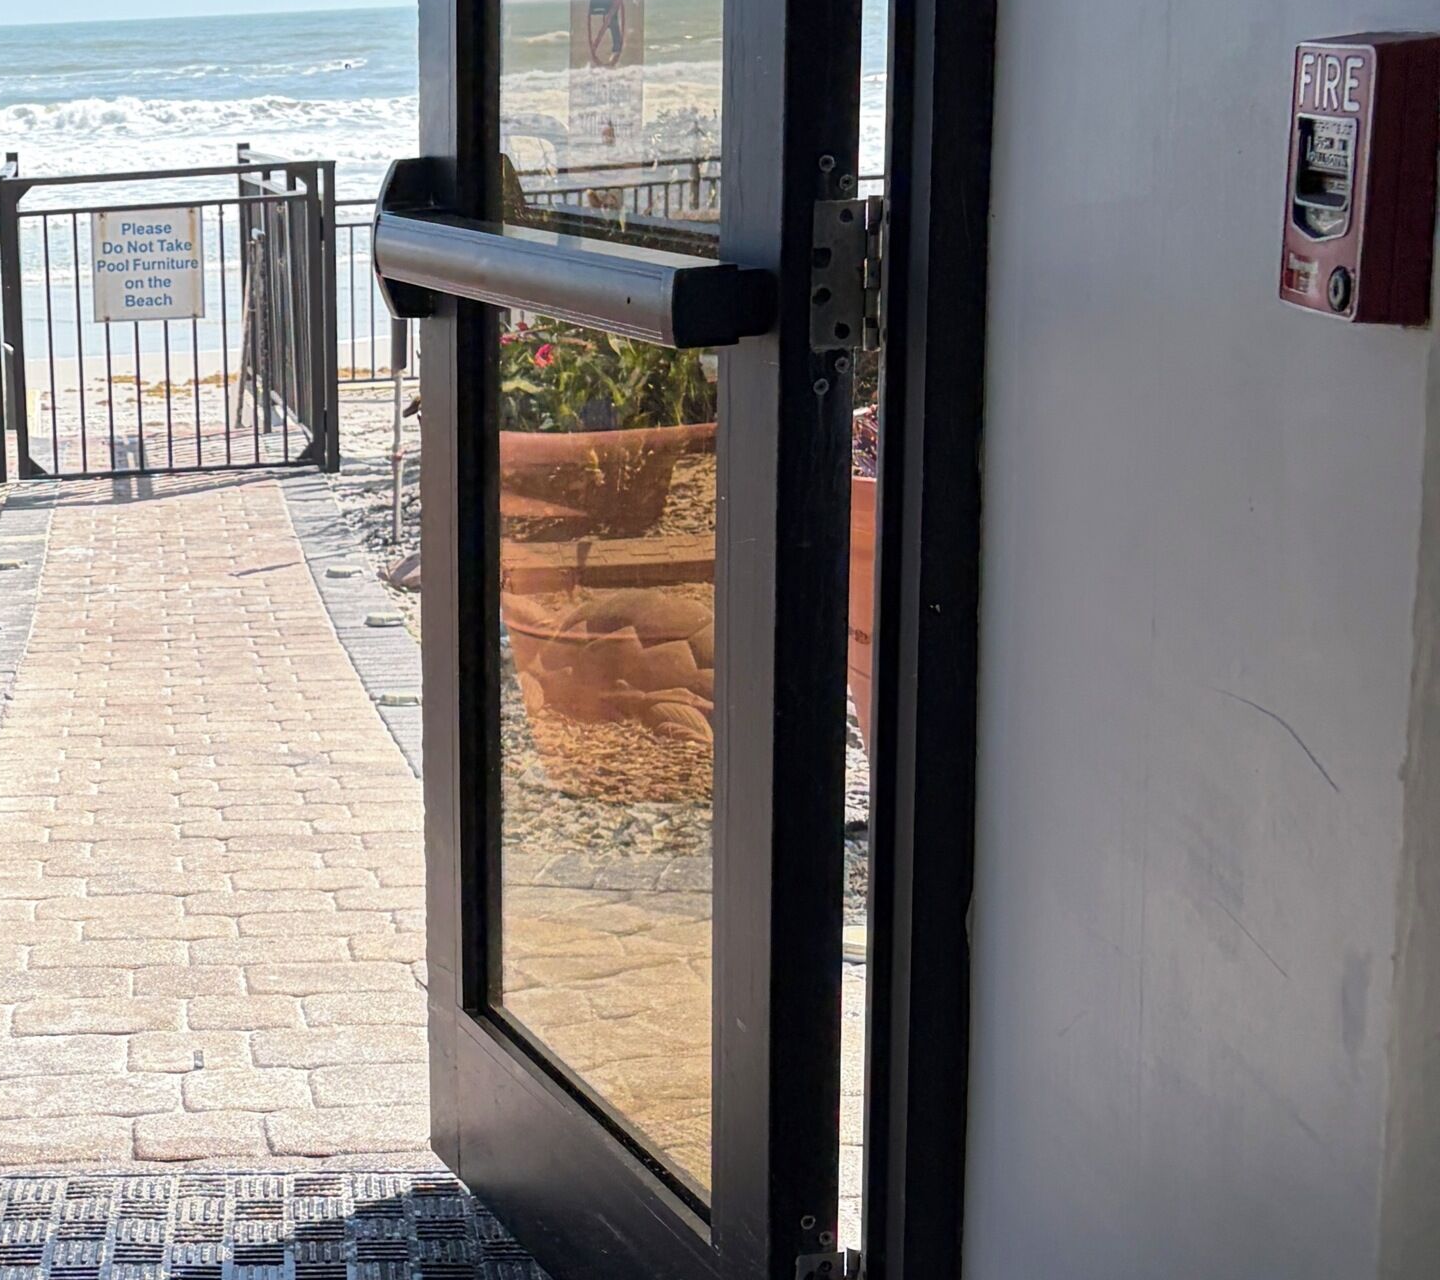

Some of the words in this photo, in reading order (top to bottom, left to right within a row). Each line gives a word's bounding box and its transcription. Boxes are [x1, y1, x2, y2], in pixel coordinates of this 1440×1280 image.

[1298, 53, 1365, 113] FIRE
[121, 223, 172, 235] Please
[102, 242, 123, 255] Do
[127, 241, 154, 253] Not
[157, 239, 192, 252] Take
[97, 260, 129, 272] Pool
[133, 258, 199, 271] Furniture
[124, 278, 144, 289] on
[148, 276, 172, 288] the
[125, 294, 173, 307] Beach
